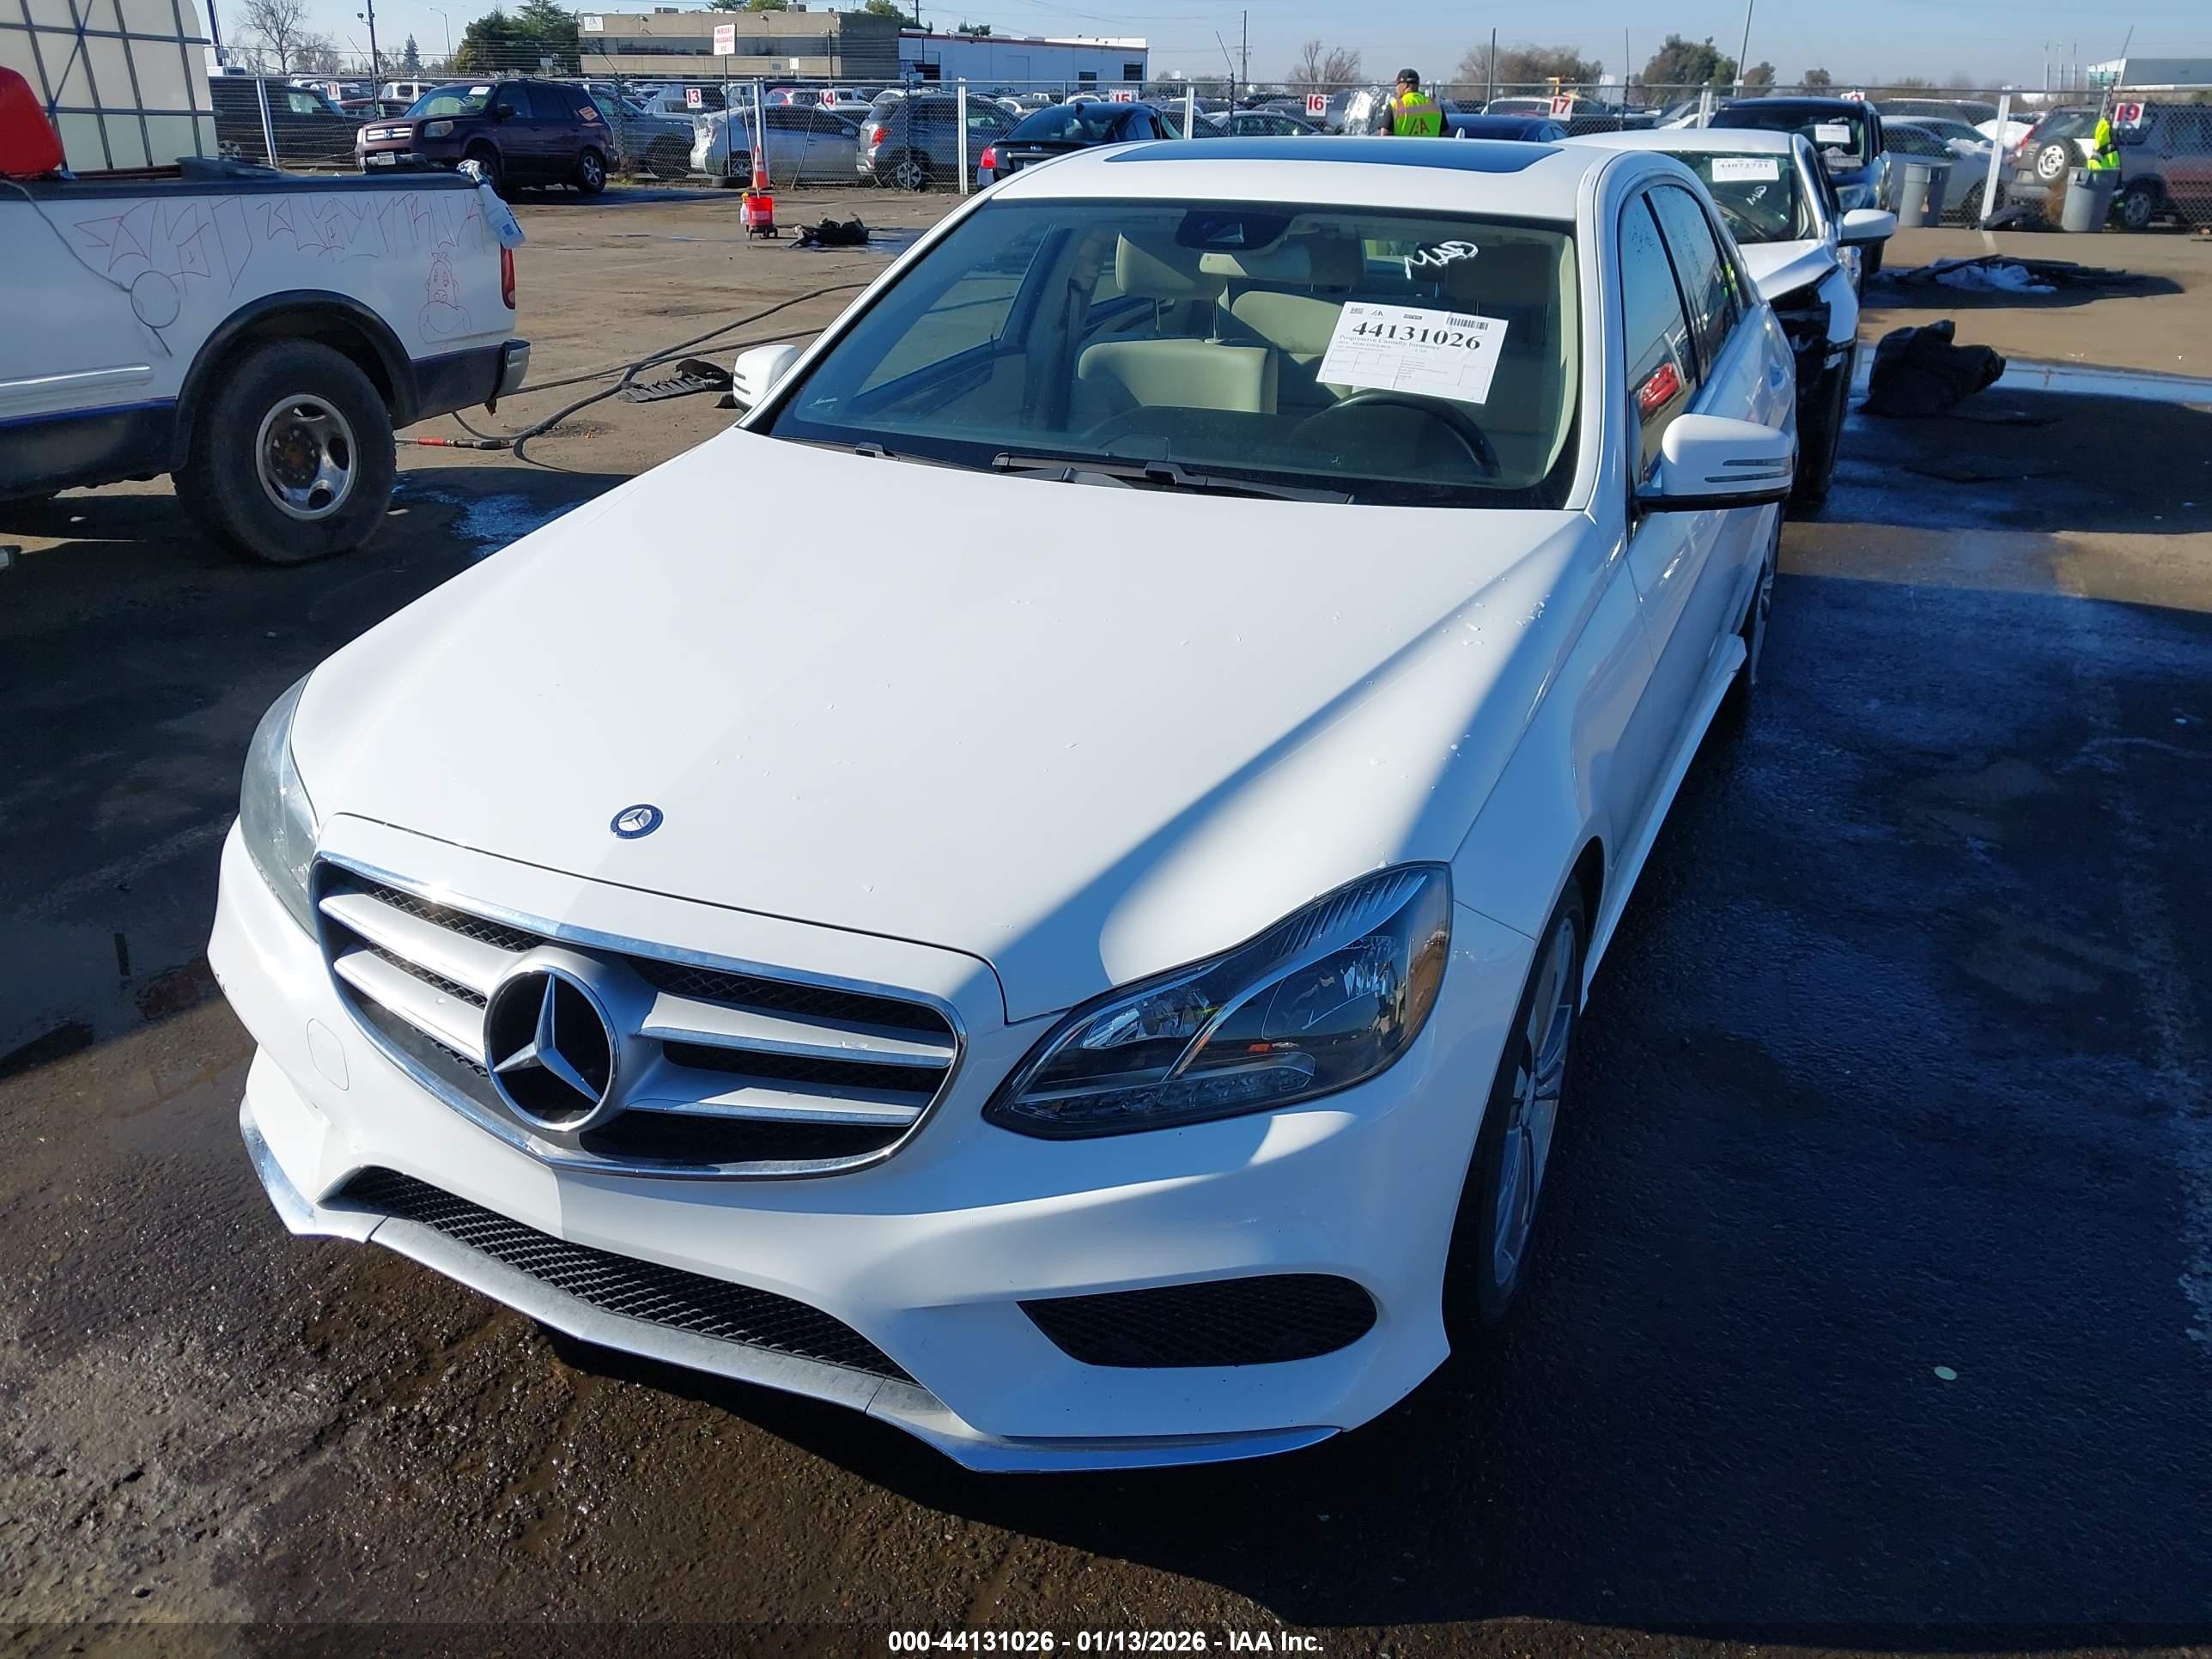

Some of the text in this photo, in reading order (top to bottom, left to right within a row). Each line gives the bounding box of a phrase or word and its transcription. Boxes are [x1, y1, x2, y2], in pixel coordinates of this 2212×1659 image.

[688, 90, 700, 103] 13
[821, 92, 835, 105] 14
[1115, 94, 1130, 102] 15
[1309, 95, 1324, 110] 16
[1552, 98, 1571, 114] 17
[2116, 104, 2140, 121] 19
[1339, 334, 1377, 343] Progressive
[1378, 337, 1407, 347] Casualty
[1408, 342, 1441, 350] Insurance
[1352, 321, 1481, 350] 44131026
